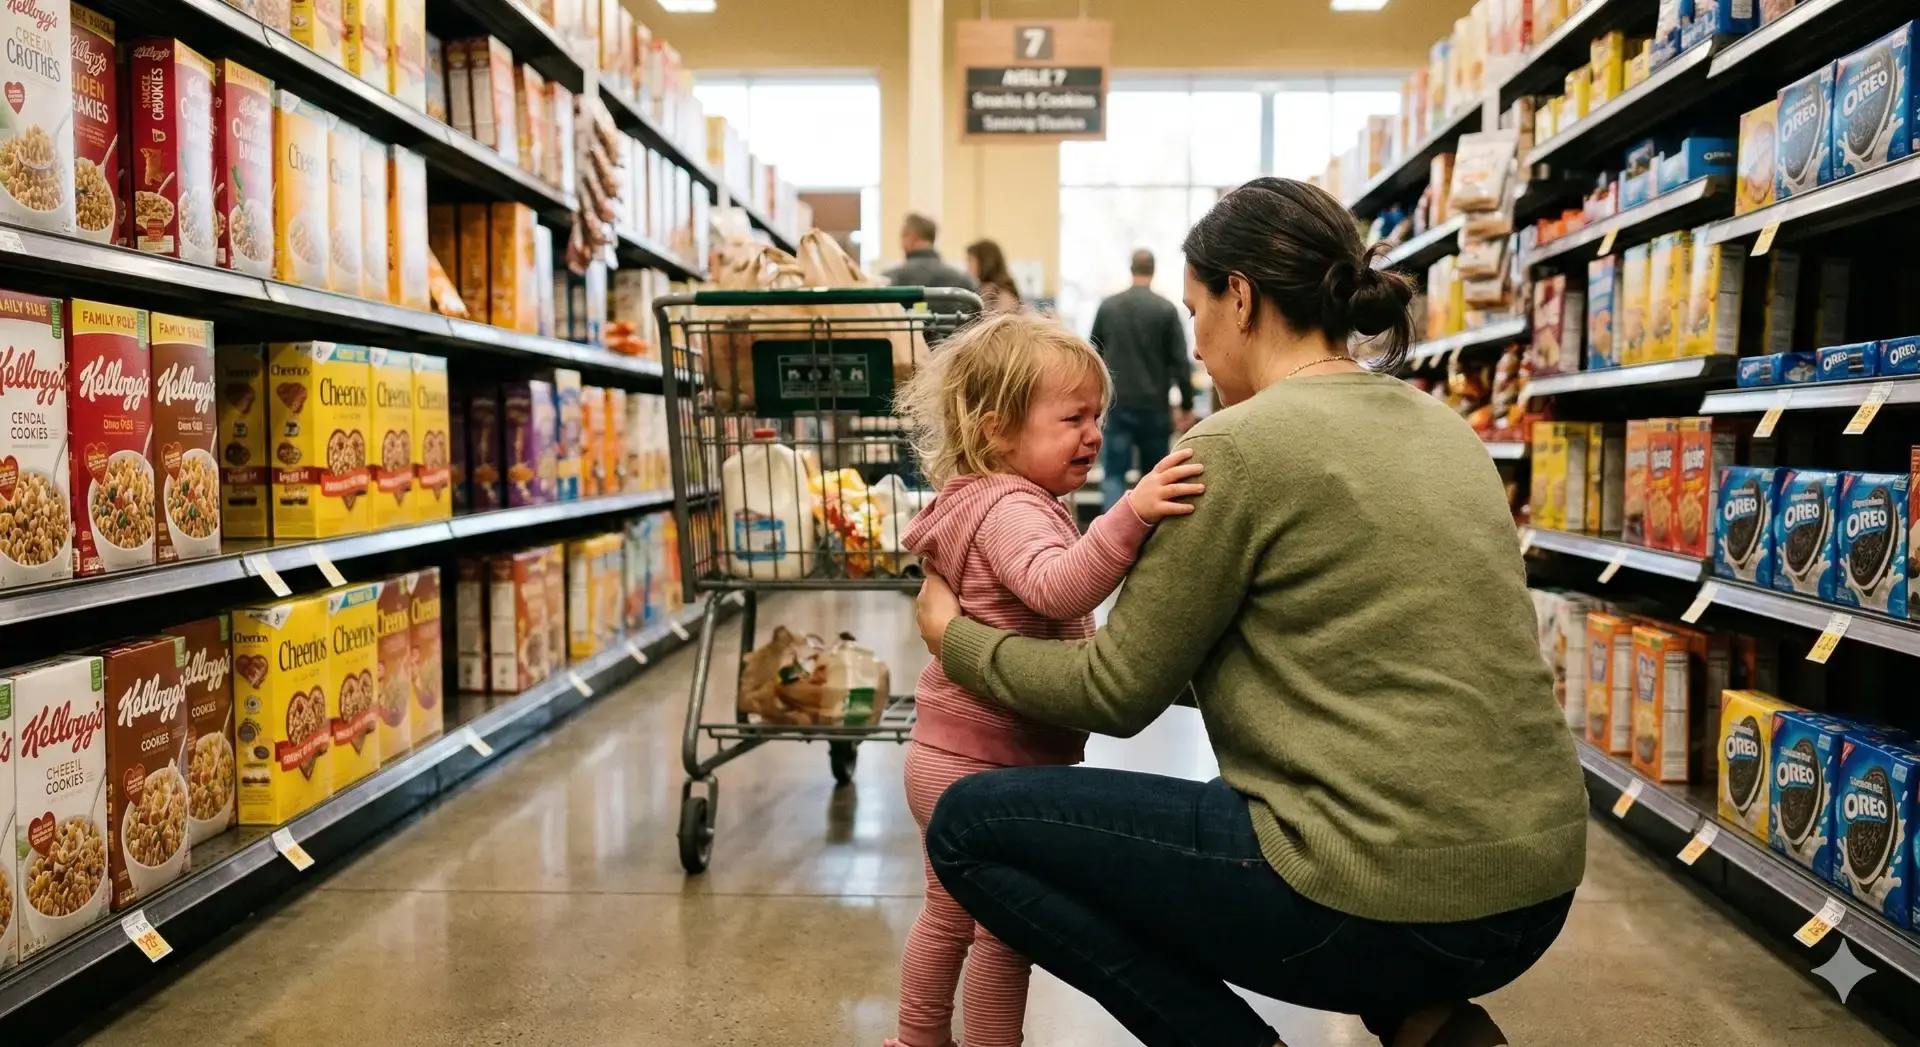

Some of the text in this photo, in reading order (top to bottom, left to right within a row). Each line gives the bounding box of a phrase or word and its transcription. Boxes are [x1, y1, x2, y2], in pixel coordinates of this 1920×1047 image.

[1023, 28, 1046, 58] 7
[6, 37, 61, 83] CROTHES
[1842, 70, 1888, 117] OREO
[1781, 103, 1818, 143] OREO
[82, 310, 115, 327] FAMILY
[158, 322, 187, 337] FAMILY
[1823, 351, 1849, 372] OREO
[1890, 343, 1917, 366] OREO
[80, 355, 150, 411] Kellogg's
[157, 362, 216, 414] Kellogg's
[319, 376, 368, 408] Cheerios
[10, 426, 48, 440] COOKIES
[1723, 497, 1758, 521] OREO
[1784, 503, 1820, 528] OREO
[1846, 510, 1888, 538] OREO
[233, 631, 269, 645] Cheerios
[332, 620, 376, 656] Cheerios
[278, 635, 328, 672] Cheerios
[117, 672, 186, 728] Kellogg's
[191, 701, 217, 718] COOKIES
[21, 700, 104, 758] Kellogg's
[140, 732, 170, 751] COOKIES
[1725, 736, 1758, 759] OREO
[46, 773, 84, 795] COOKIES
[1777, 761, 1815, 787] OREO
[1844, 793, 1888, 820] OREO
